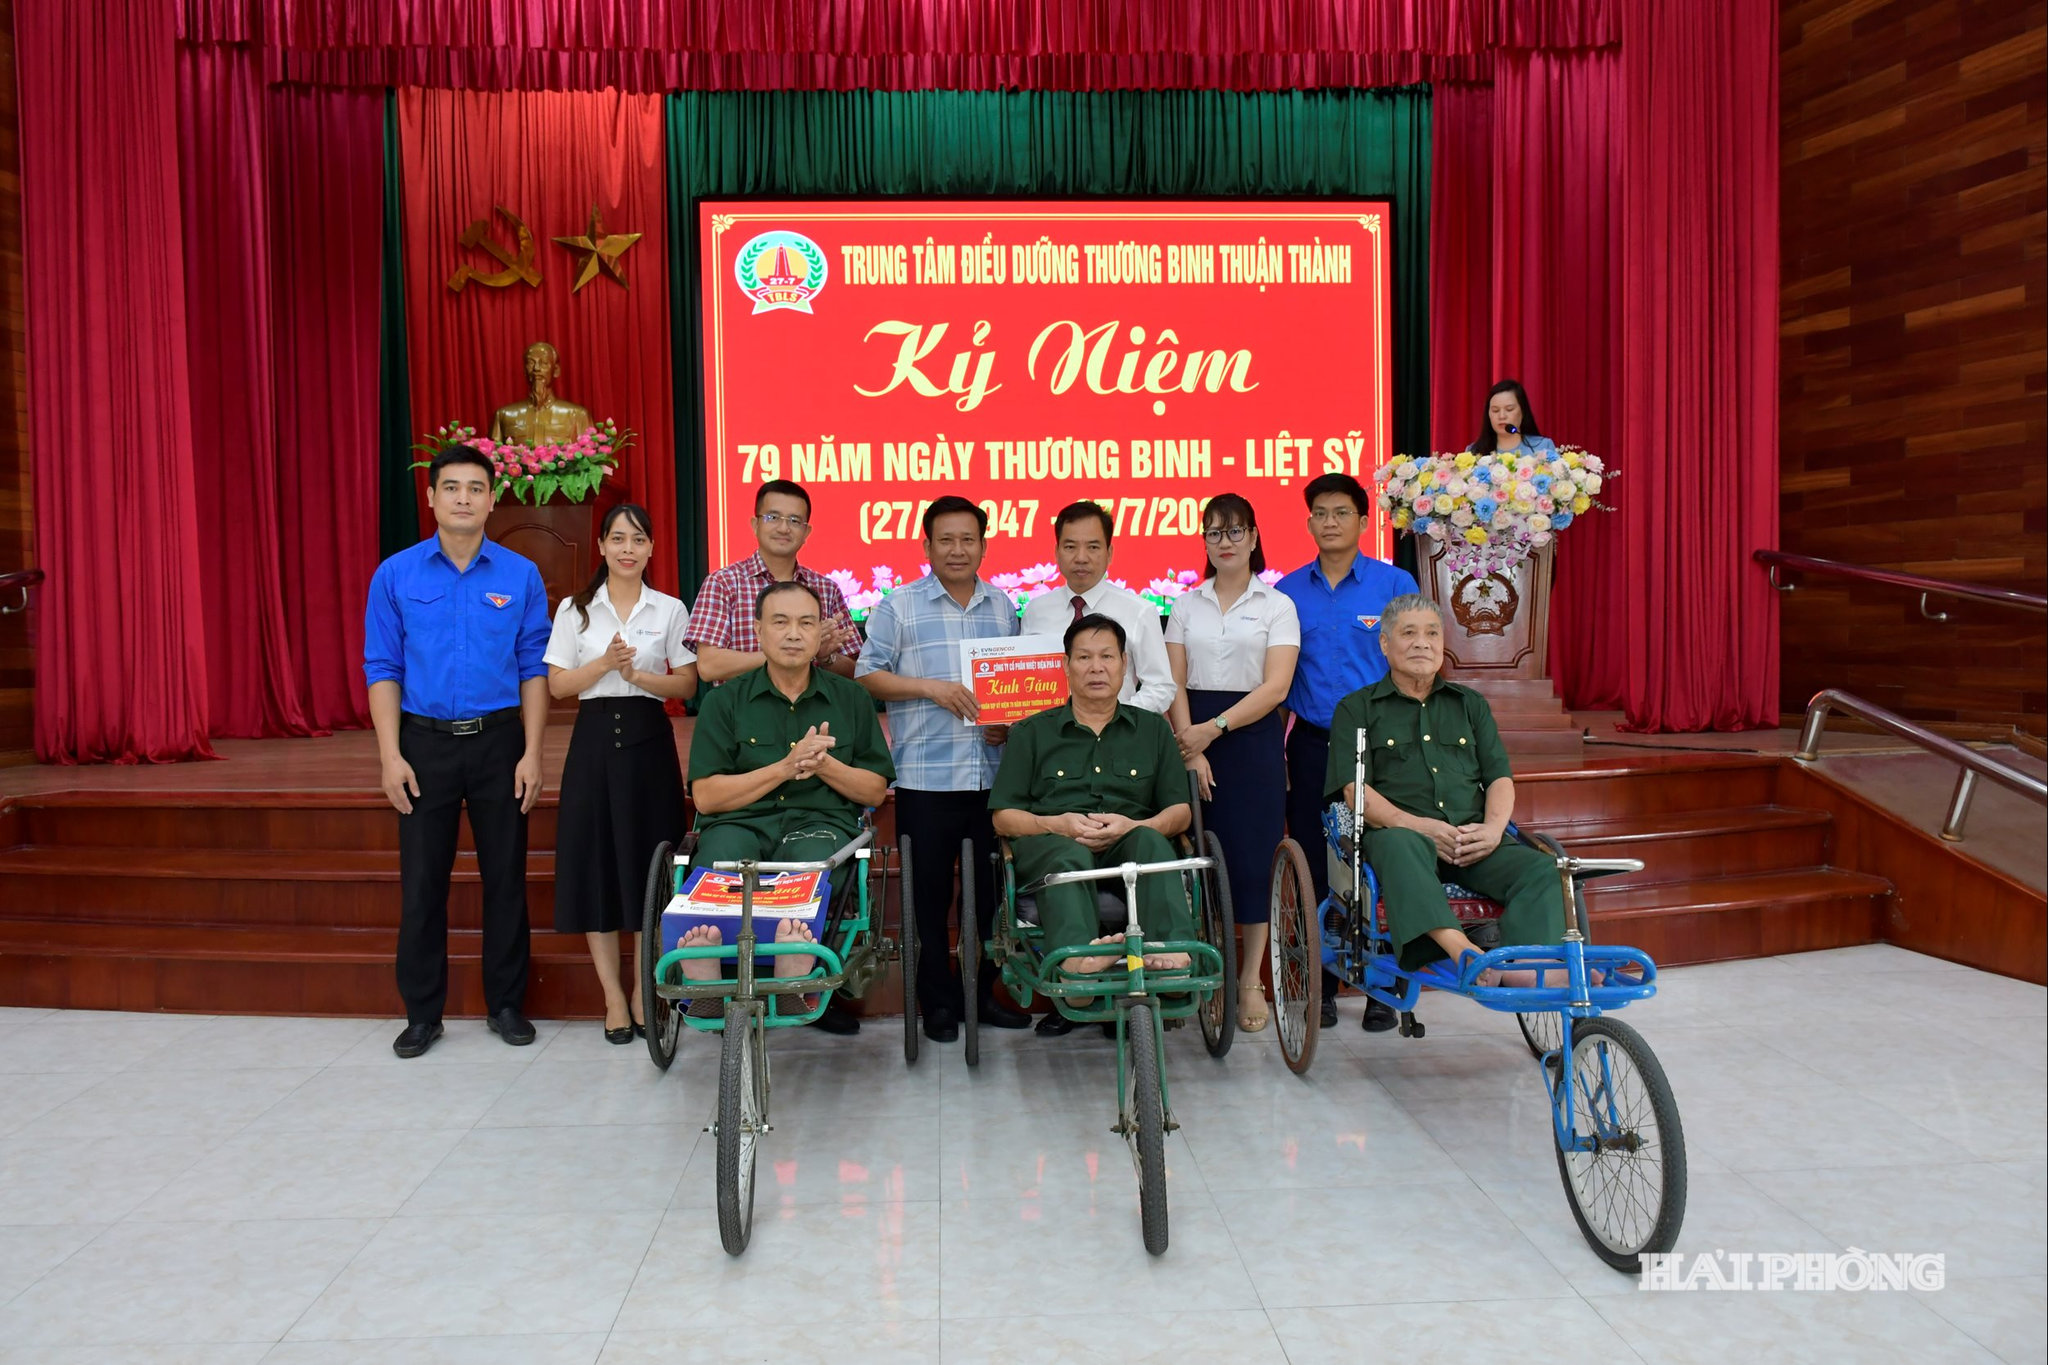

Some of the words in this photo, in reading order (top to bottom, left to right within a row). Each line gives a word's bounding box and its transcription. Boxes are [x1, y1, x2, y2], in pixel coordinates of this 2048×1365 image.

[841, 245, 907, 285] TRUNG
[912, 237, 955, 284] TÂM
[961, 232, 1006, 284] ĐIỀU
[1012, 236, 1079, 284] DƯỠNG
[1084, 241, 1162, 284] THƯƠNG
[1168, 245, 1214, 283] BINH
[1219, 237, 1283, 292] THUẬN
[1288, 237, 1351, 283] THÀNH
[767, 292, 798, 302] TBLS
[769, 277, 796, 286] 27-7
[854, 320, 1002, 412] Kỷ
[1028, 321, 1259, 415] Niệm
[738, 444, 780, 483] 79
[792, 435, 871, 482] NĂM
[883, 434, 974, 481] NGÀY
[985, 437, 1119, 480] THƯƠNG
[1131, 440, 1211, 478] BINH
[1223, 457, 1234, 466] -
[1246, 431, 1312, 485] LIỆT
[1323, 431, 1364, 476] SỸ
[1024, 676, 1058, 695] Tặng
